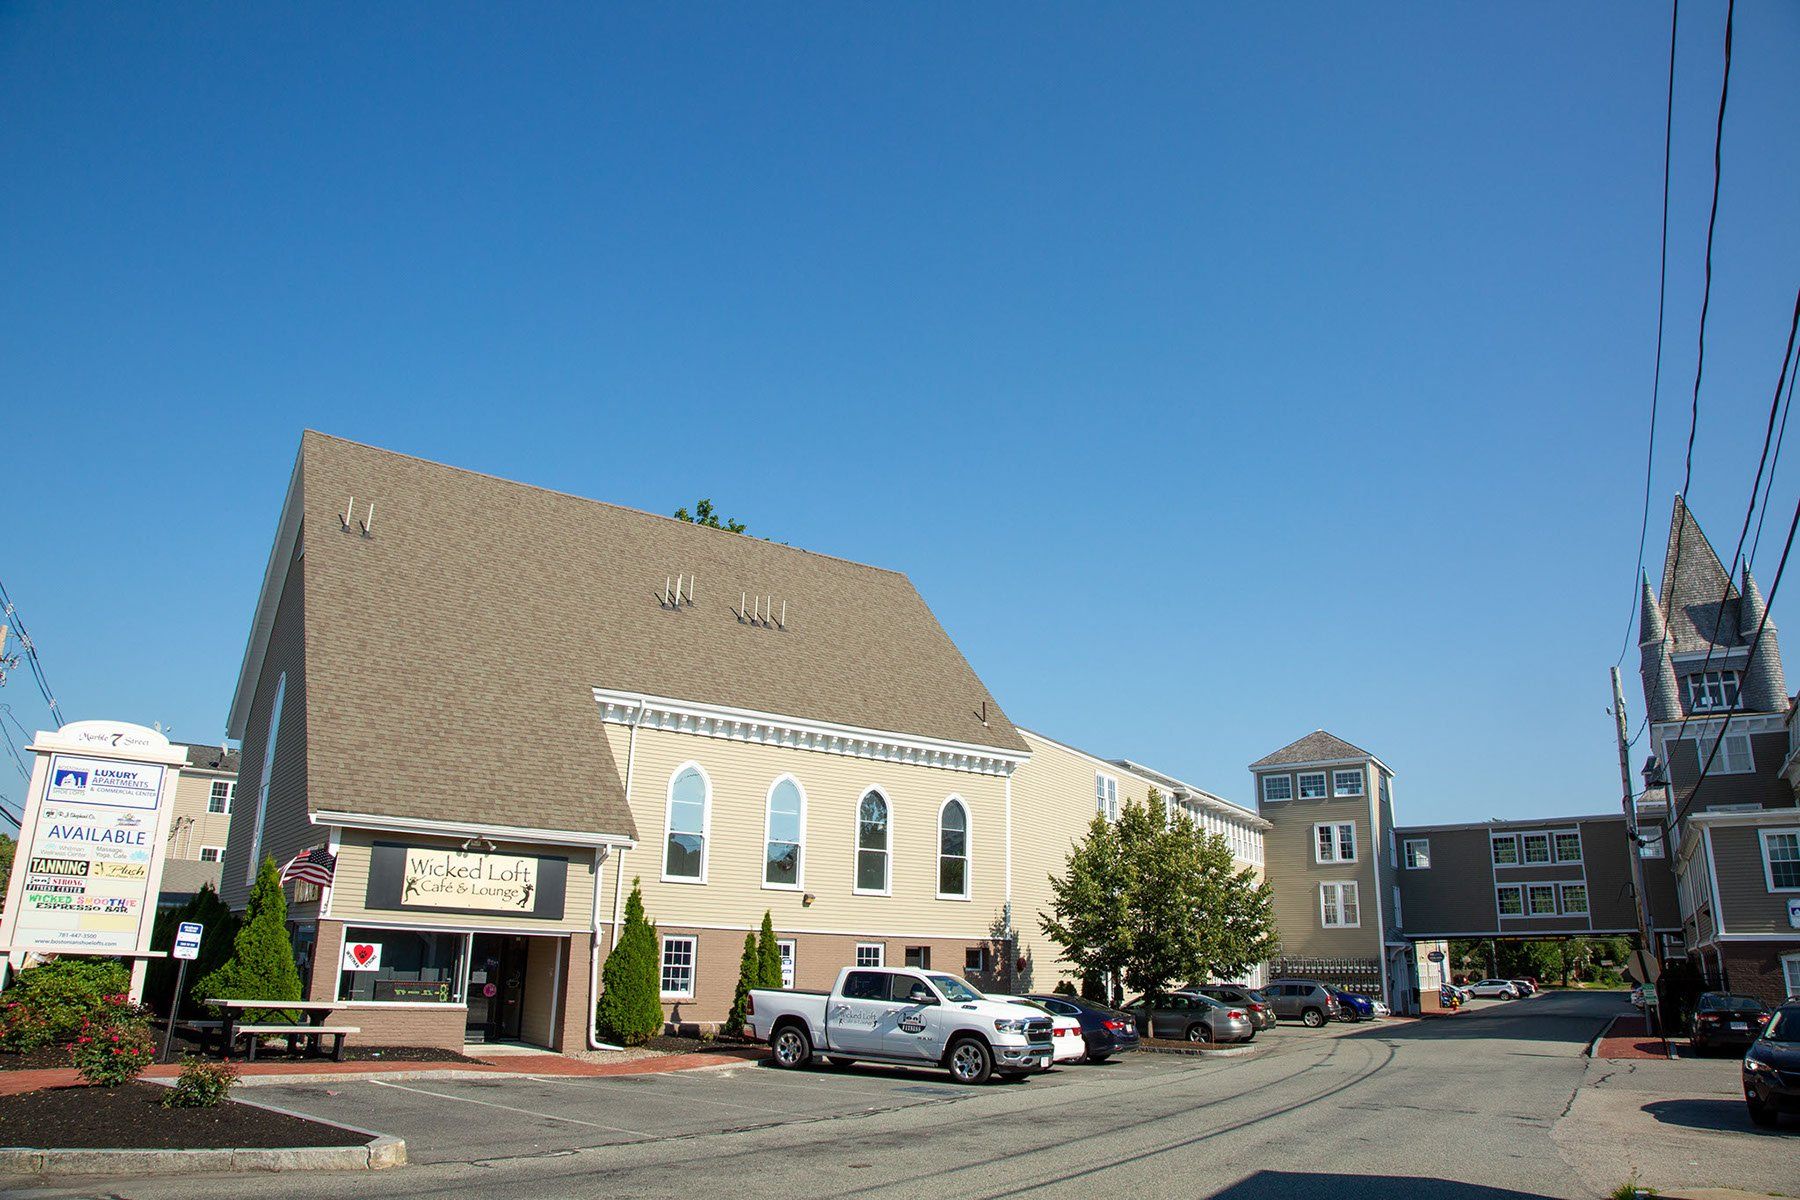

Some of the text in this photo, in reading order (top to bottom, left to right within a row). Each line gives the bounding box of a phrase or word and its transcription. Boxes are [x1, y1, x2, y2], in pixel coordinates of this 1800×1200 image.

[79, 732, 150, 747] Marble 7 Street
[94, 769, 138, 779] LUXURY
[92, 777, 149, 787] APARTMENTS
[97, 787, 135, 796] COMMERCIAL
[48, 825, 146, 845] AVAILABLE
[32, 858, 87, 875] TANNING
[109, 864, 145, 876] Plush
[411, 855, 531, 883] Wicked Loft
[52, 878, 83, 886] STRONG
[420, 877, 519, 902] Café & Lounge
[29, 894, 136, 907] WICKED SMOOTHIE
[35, 902, 129, 914] ESPRESSO BAR
